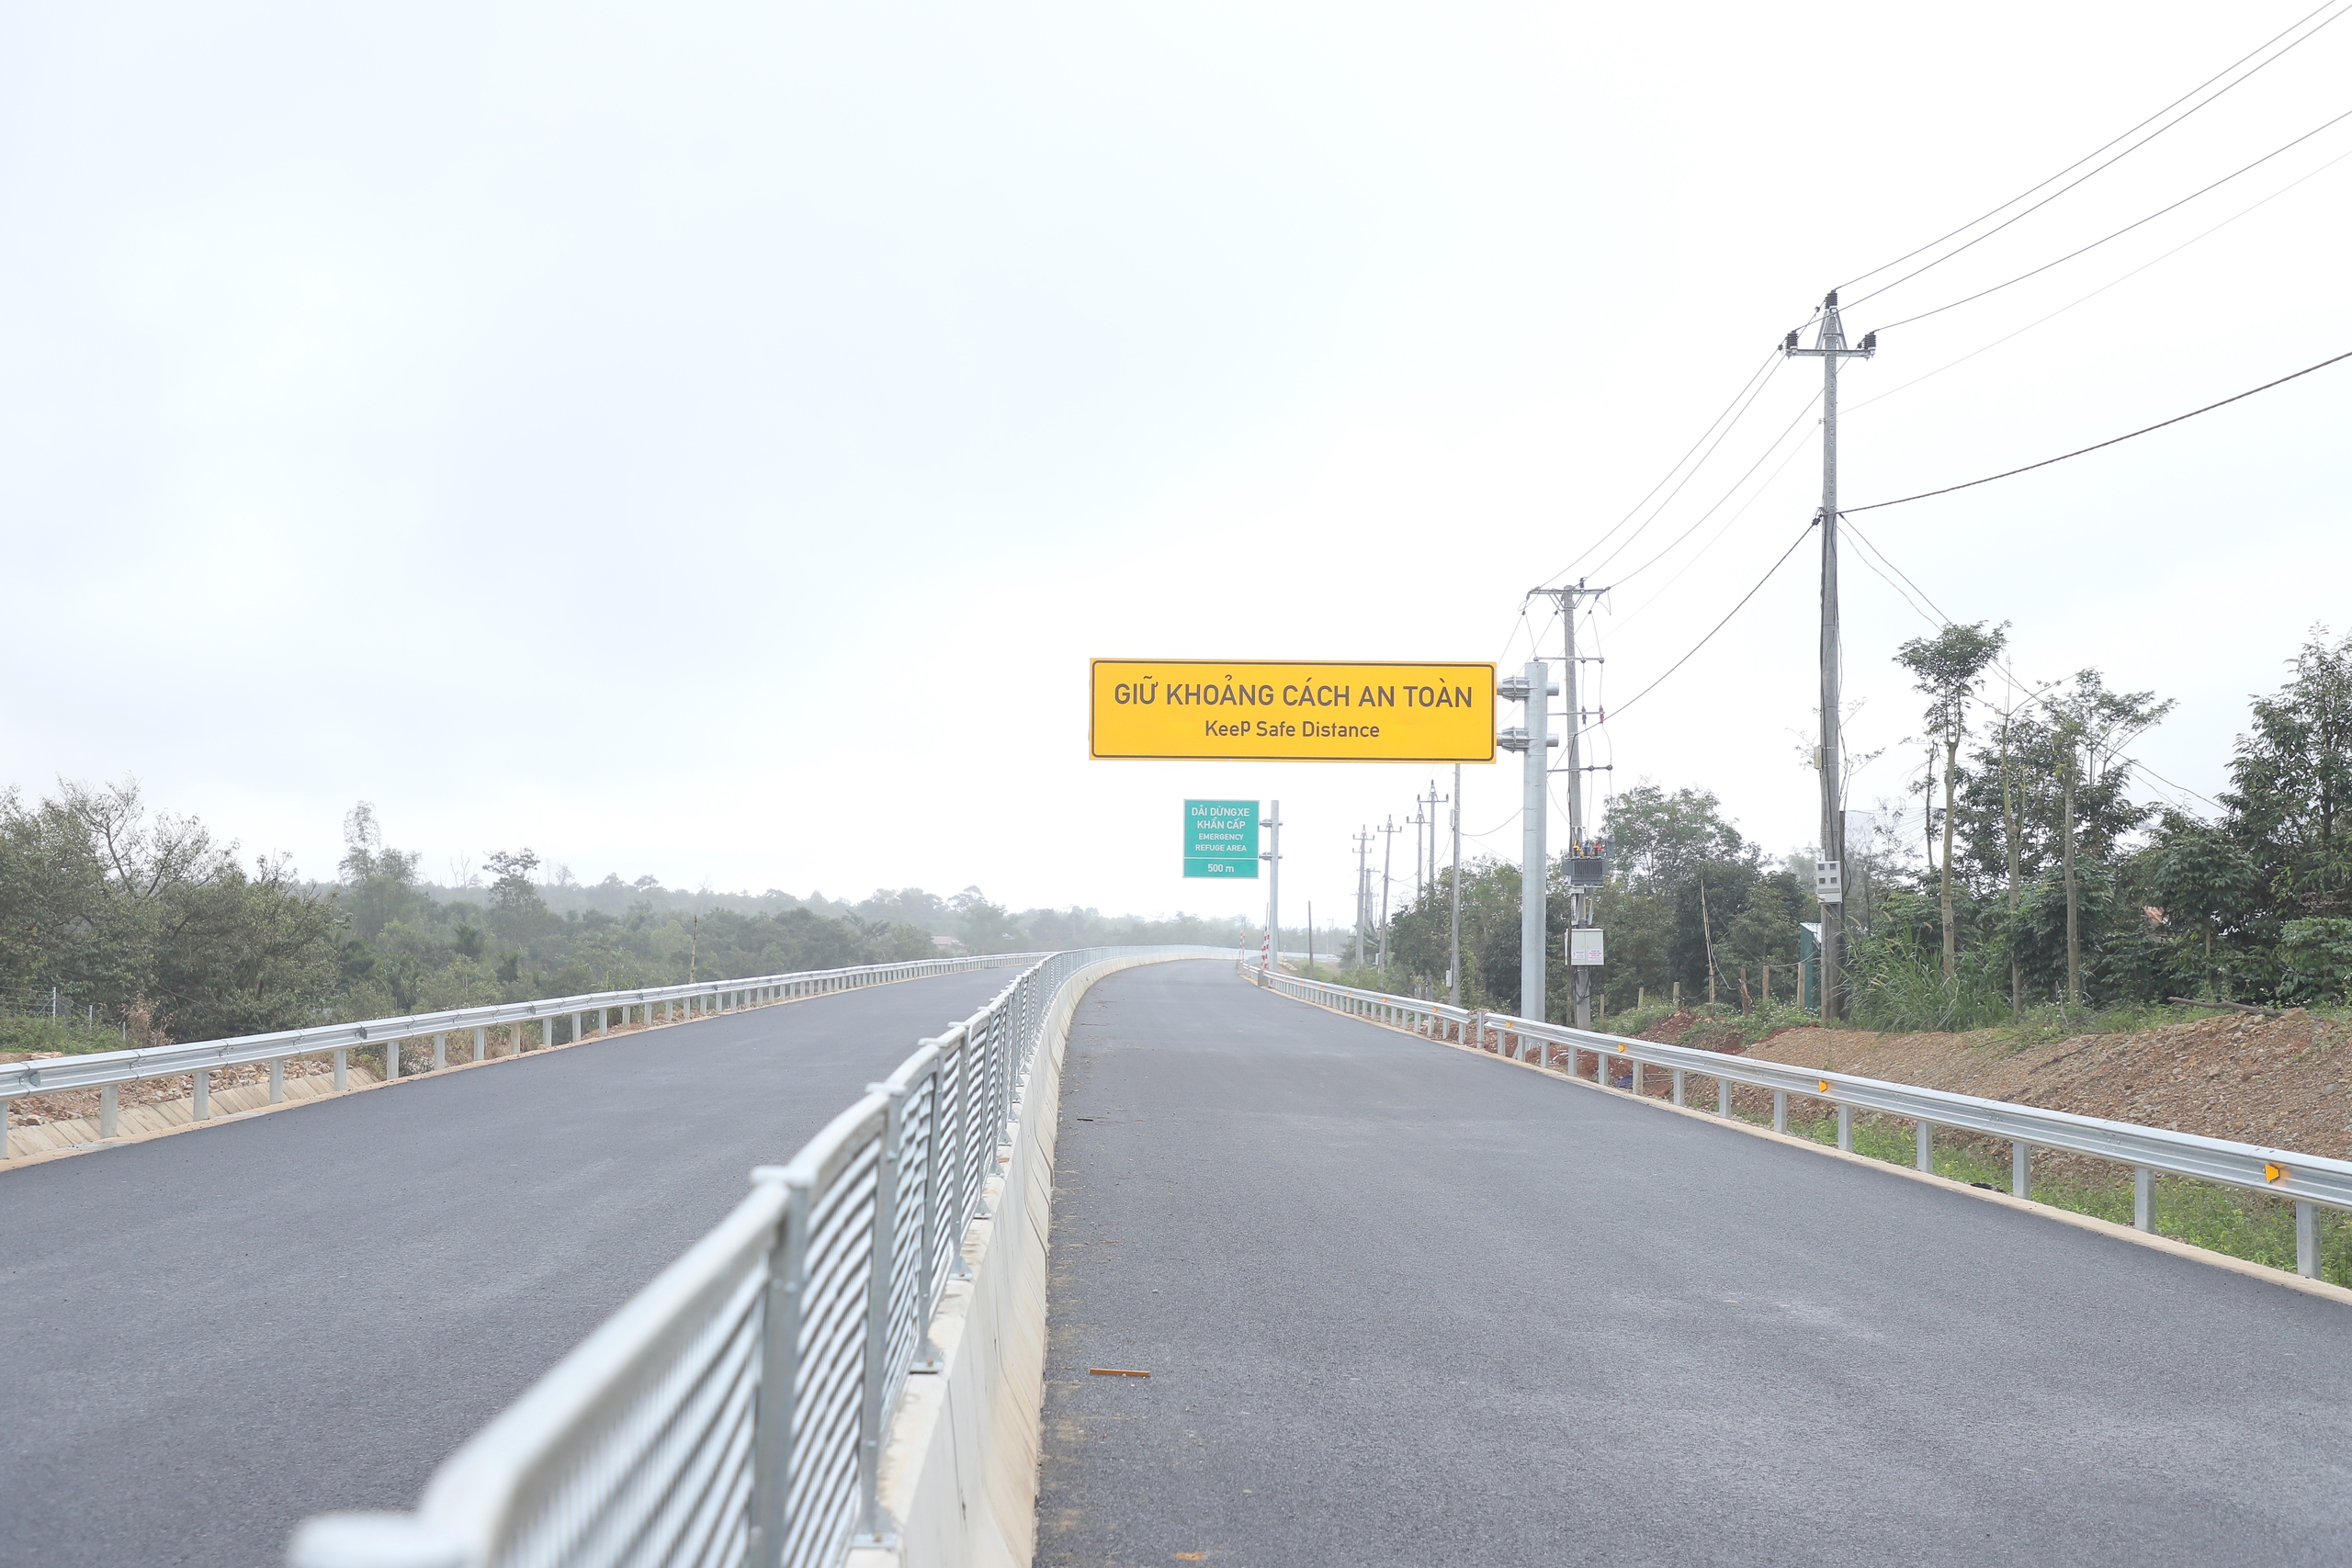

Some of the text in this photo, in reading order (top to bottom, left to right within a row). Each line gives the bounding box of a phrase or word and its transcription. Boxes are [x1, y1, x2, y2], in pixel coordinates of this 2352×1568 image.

[1114, 674, 1472, 707] GIỮ KHOẢNG CÁCH AN TOÀN
[1256, 720, 1295, 737] Safe
[1302, 721, 1380, 737] Distance
[1192, 805, 1207, 816] DẢI
[1197, 817, 1246, 829] KHẨN CẤP
[1208, 863, 1223, 873] 500
